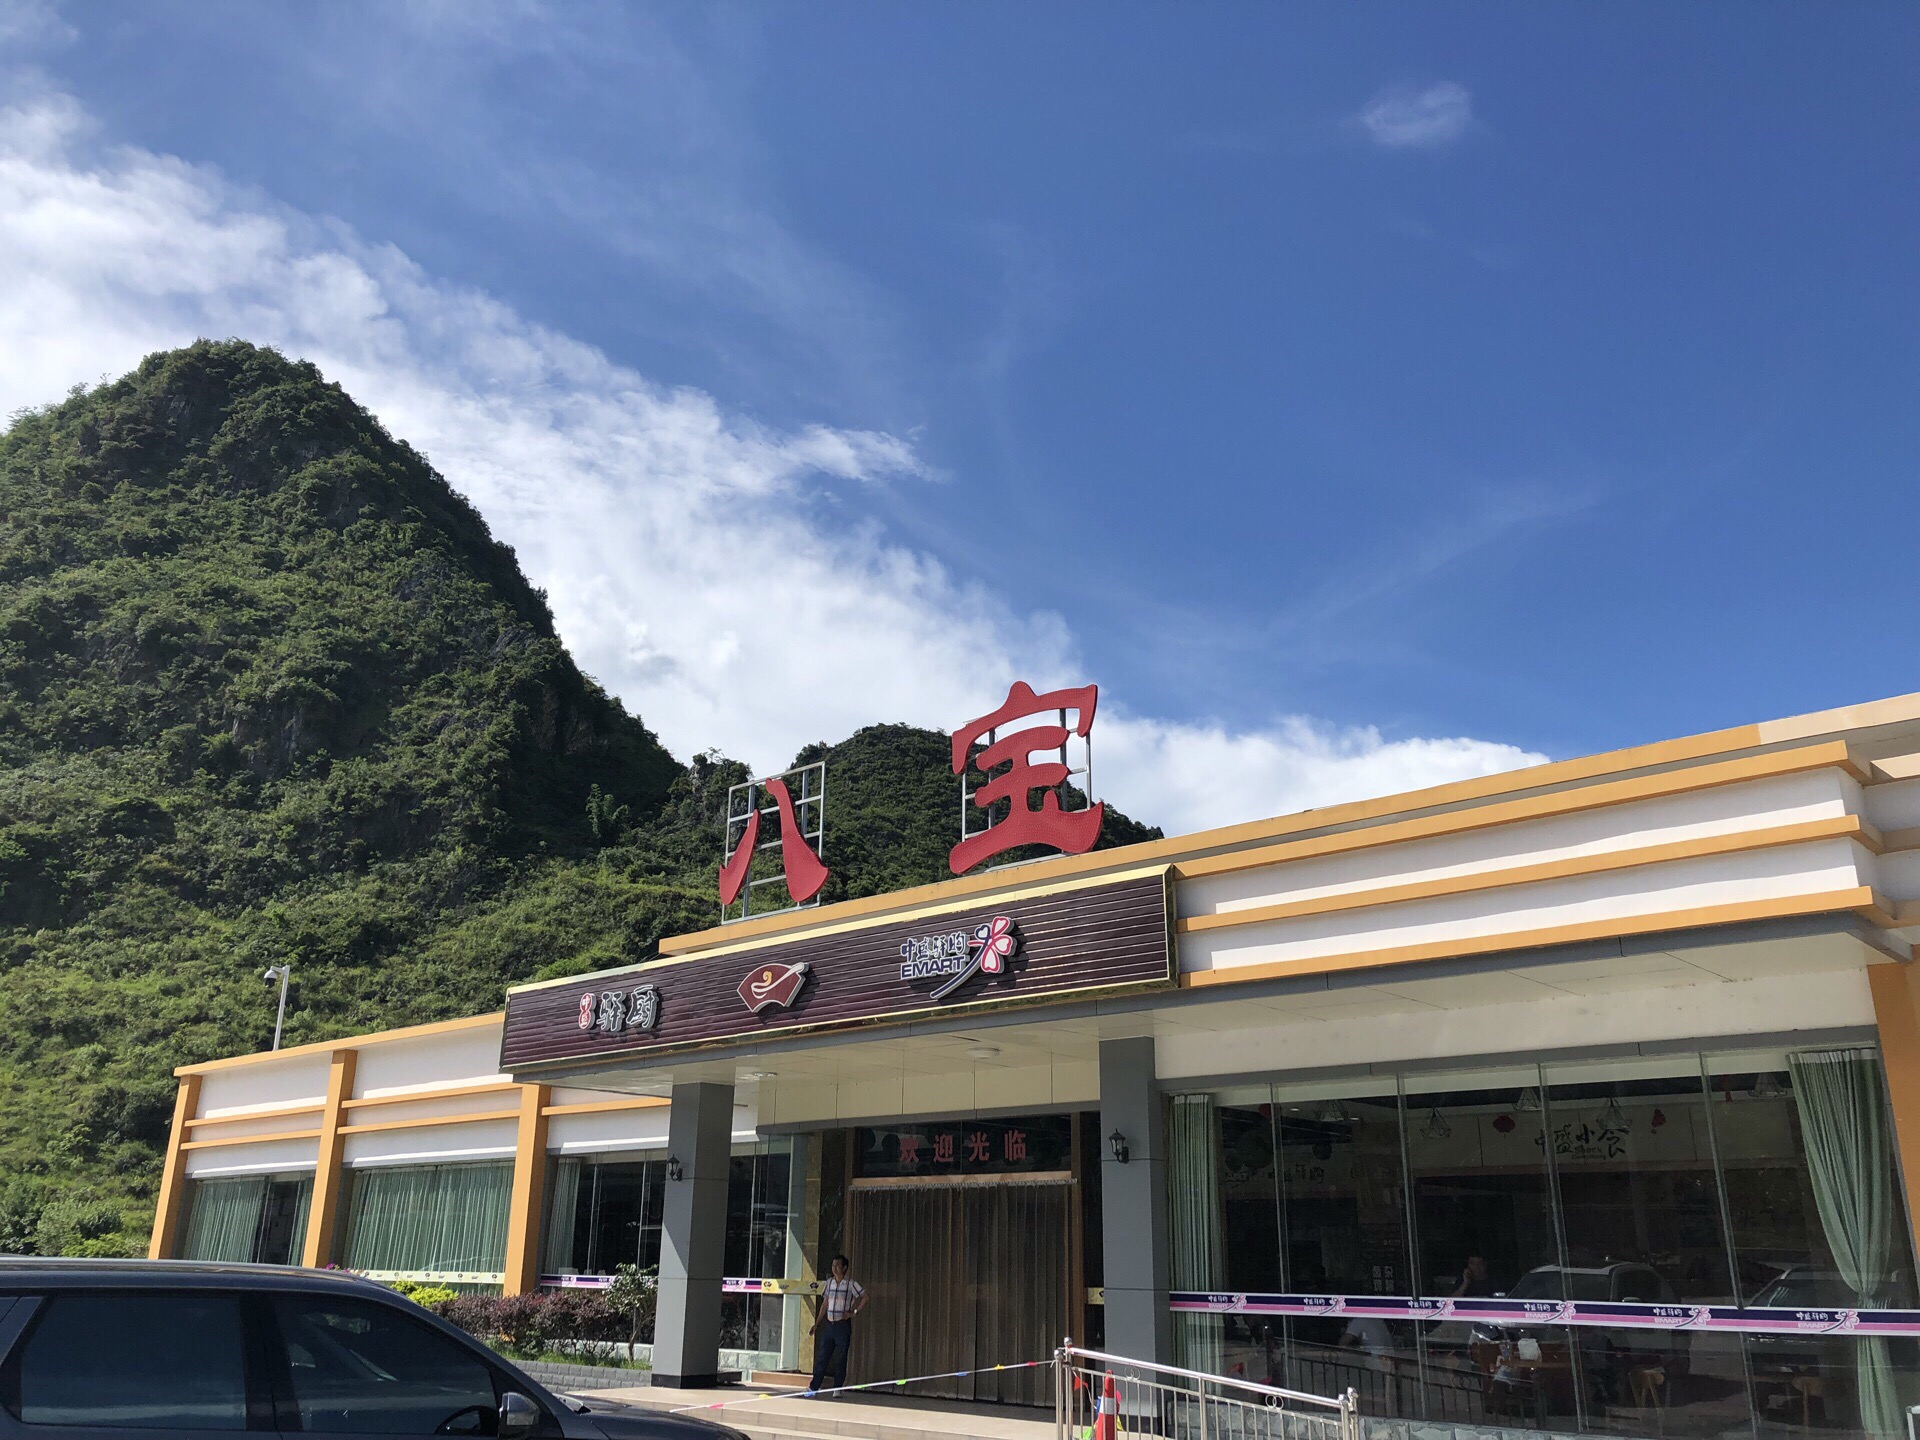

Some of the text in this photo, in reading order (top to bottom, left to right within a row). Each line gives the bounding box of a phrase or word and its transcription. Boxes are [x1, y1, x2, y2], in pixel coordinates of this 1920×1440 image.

[718, 680, 1104, 906] 八宝
[901, 956, 966, 979] EMART
[899, 1130, 1026, 1164] 欢迎光临
